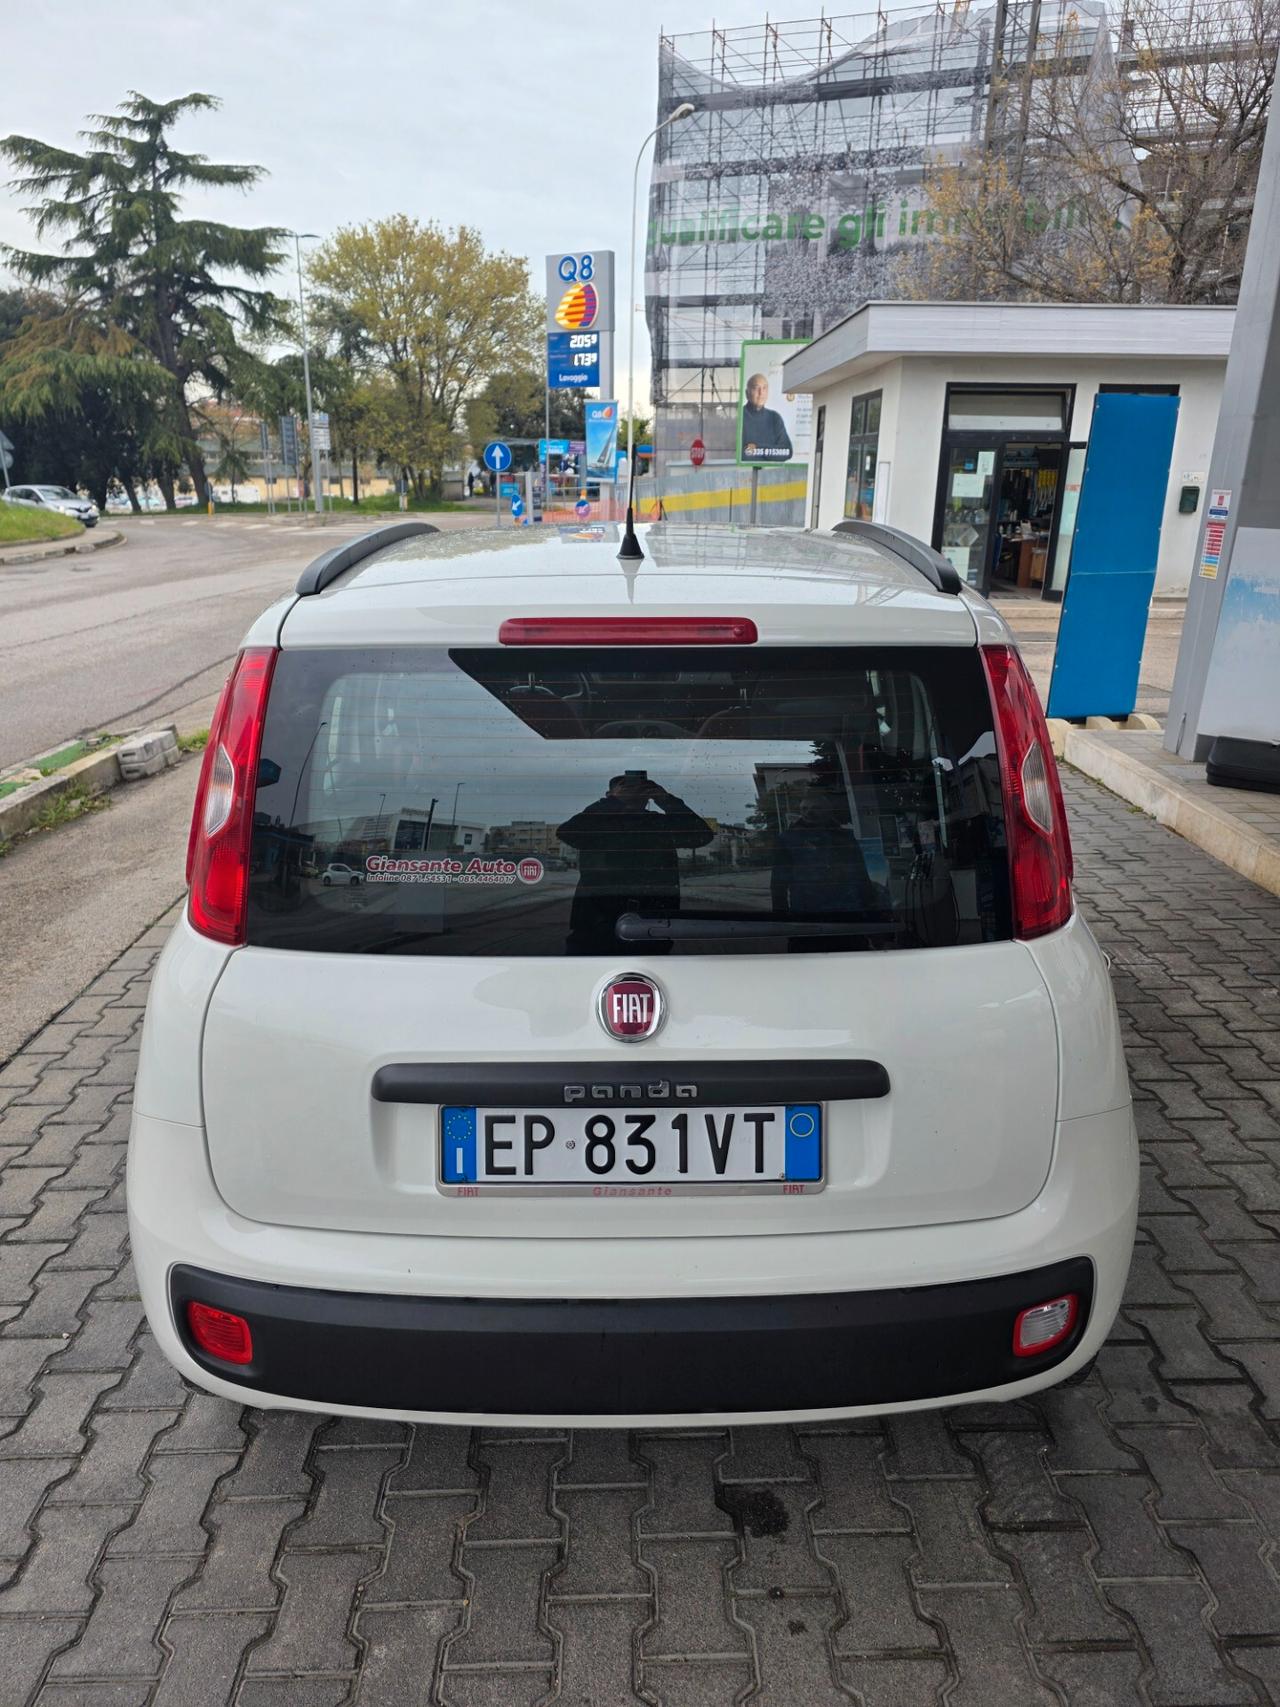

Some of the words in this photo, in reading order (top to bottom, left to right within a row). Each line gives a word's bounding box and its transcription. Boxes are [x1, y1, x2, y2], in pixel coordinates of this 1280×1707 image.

[838, 201, 885, 248] gli
[558, 254, 593, 281] Q8
[366, 855, 463, 874] Giansante
[465, 857, 516, 875] Auto
[523, 865, 538, 876] FIAT
[366, 872, 400, 883] Infoline
[612, 993, 651, 1023] FIAT
[563, 1079, 698, 1102] panda
[456, 1147, 464, 1174] I
[484, 1114, 555, 1175] EP
[585, 1112, 775, 1175] 831VT
[457, 1186, 480, 1197] FIAT
[592, 1186, 673, 1198] Giansante
[783, 1184, 805, 1194] FIAT
